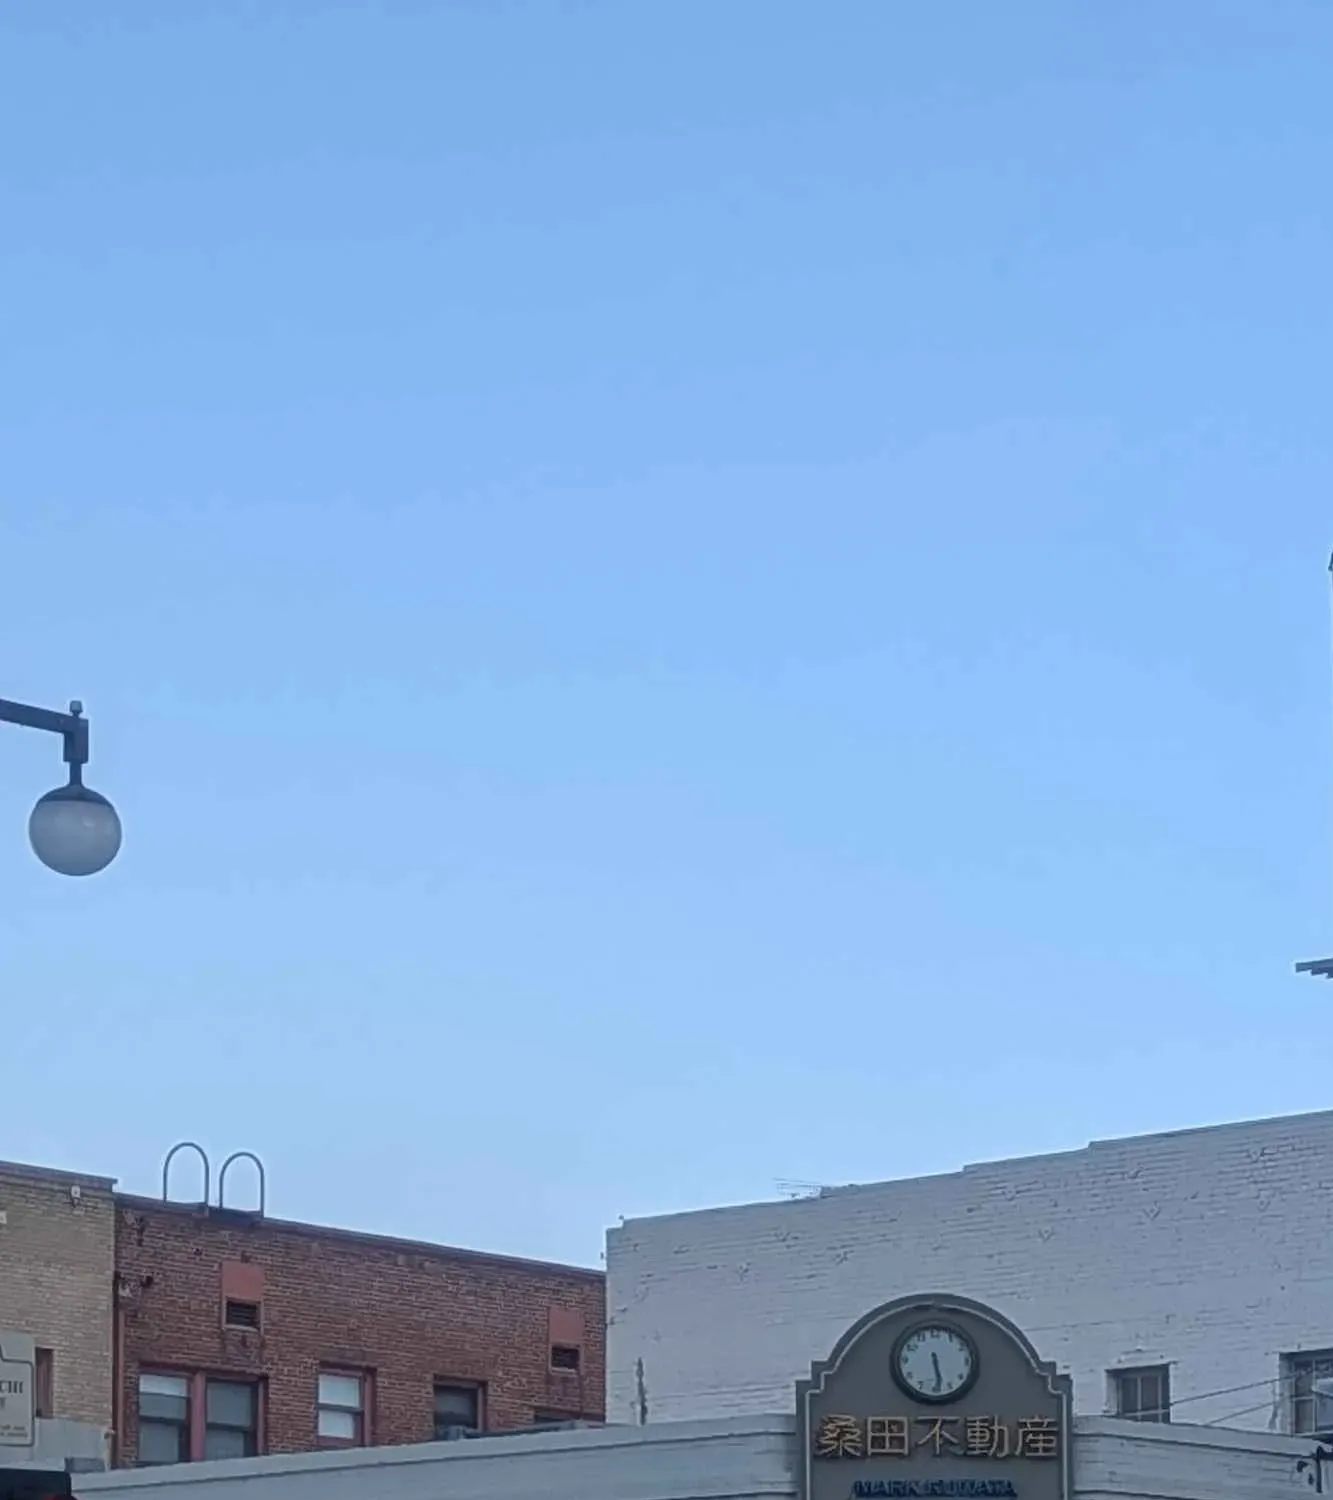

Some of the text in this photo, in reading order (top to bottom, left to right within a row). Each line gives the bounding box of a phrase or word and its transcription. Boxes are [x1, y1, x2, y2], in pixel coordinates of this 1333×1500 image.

[817, 1414, 1058, 1457] 桑田不動産
[854, 1479, 922, 1498] MARK
